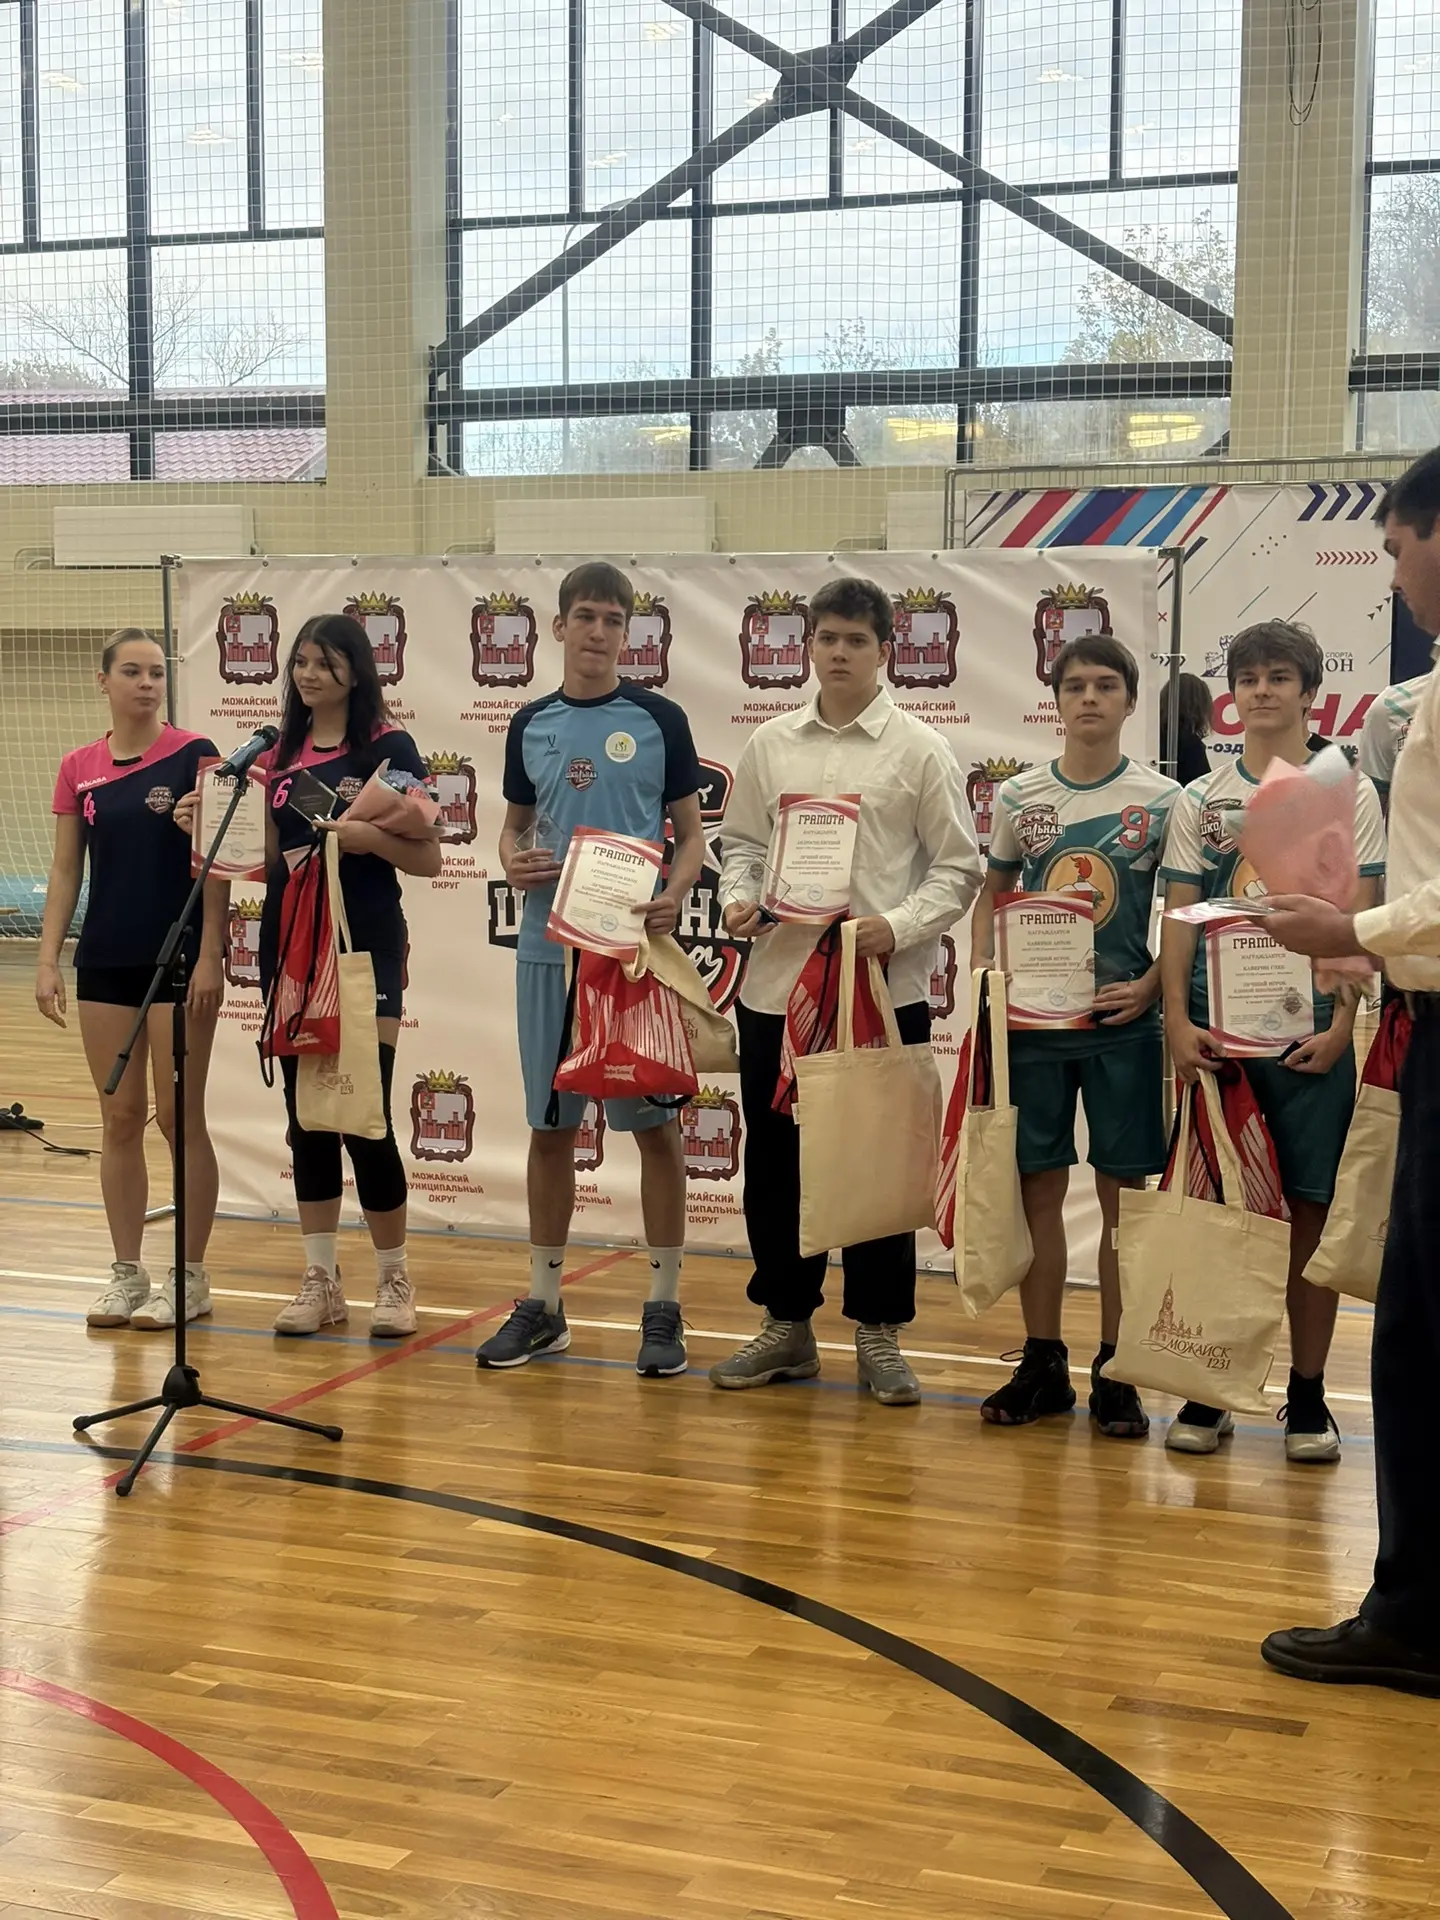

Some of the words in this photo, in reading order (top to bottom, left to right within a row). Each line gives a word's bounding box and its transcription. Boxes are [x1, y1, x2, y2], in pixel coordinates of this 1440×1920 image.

[222, 696, 278, 706] МОЖАЙСКИЙ
[894, 700, 956, 711] ОЖАЙСКИЙ
[210, 709, 285, 718] МУНИЦИПАЛЬНЫ
[460, 713, 512, 721] МУНИЦИПА
[236, 721, 263, 729] ОКРУГ
[213, 776, 254, 788] ГРАМА
[272, 777, 293, 808] 6
[83, 792, 96, 826] 4
[798, 814, 845, 825] ГРАМОТА
[1119, 804, 1150, 850] 9
[441, 856, 475, 866] АЙСКИЙ
[593, 846, 646, 866] ГРАМОТА
[432, 881, 460, 889] ОКРУГ
[1019, 913, 1077, 925] ГРАМОТА
[1232, 936, 1283, 949] ГРАМО
[412, 1172, 469, 1183] МОЖАЙСКИЙ
[428, 1195, 457, 1203] ОКРУГ
[686, 1192, 734, 1203] ЖАЙСКИЙ
[688, 1216, 719, 1225] ОКРУГ
[1165, 1339, 1232, 1358] МОЖАЙСК
[1206, 1358, 1232, 1370] 1231
